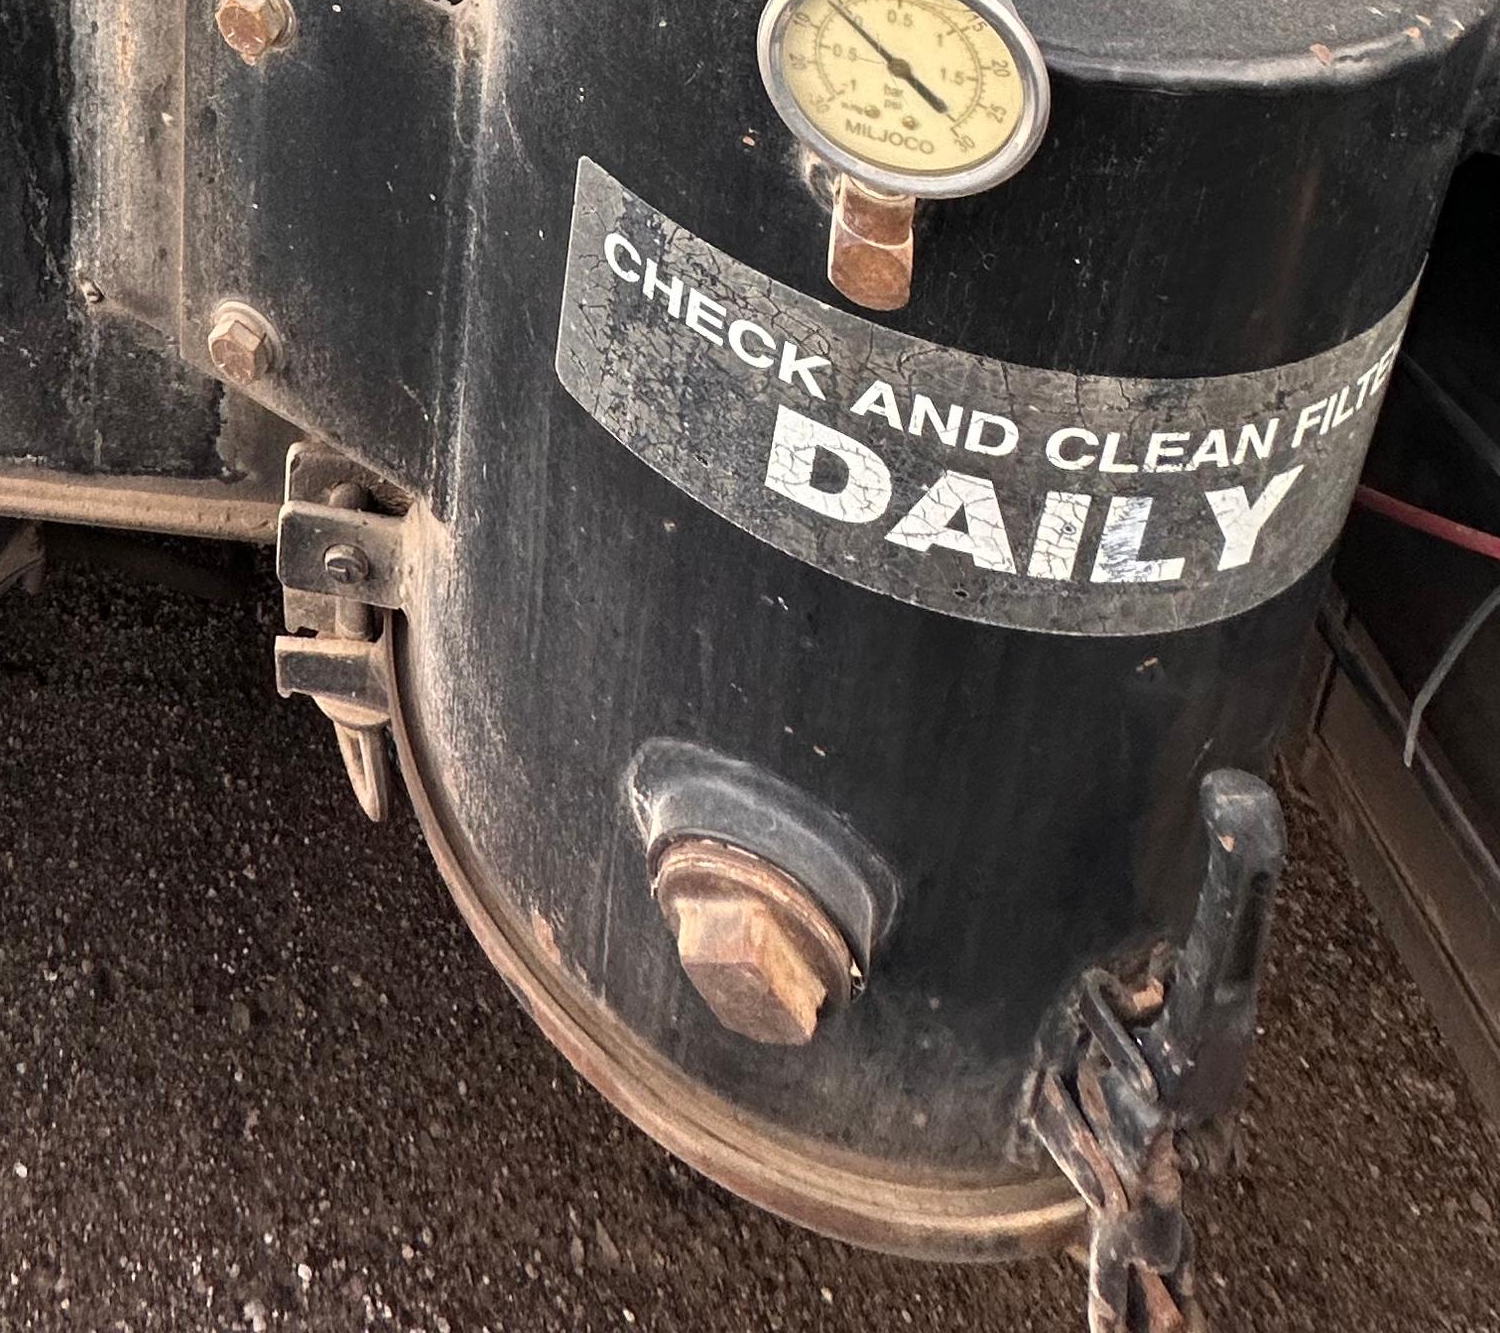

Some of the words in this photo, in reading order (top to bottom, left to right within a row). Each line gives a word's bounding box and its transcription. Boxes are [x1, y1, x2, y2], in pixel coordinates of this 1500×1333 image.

[603, 232, 831, 399] CHECK
[849, 380, 1019, 456] AND
[1045, 418, 1280, 474] CLEAN
[1291, 343, 1401, 448] FILTE
[763, 404, 1303, 584] DAILY
